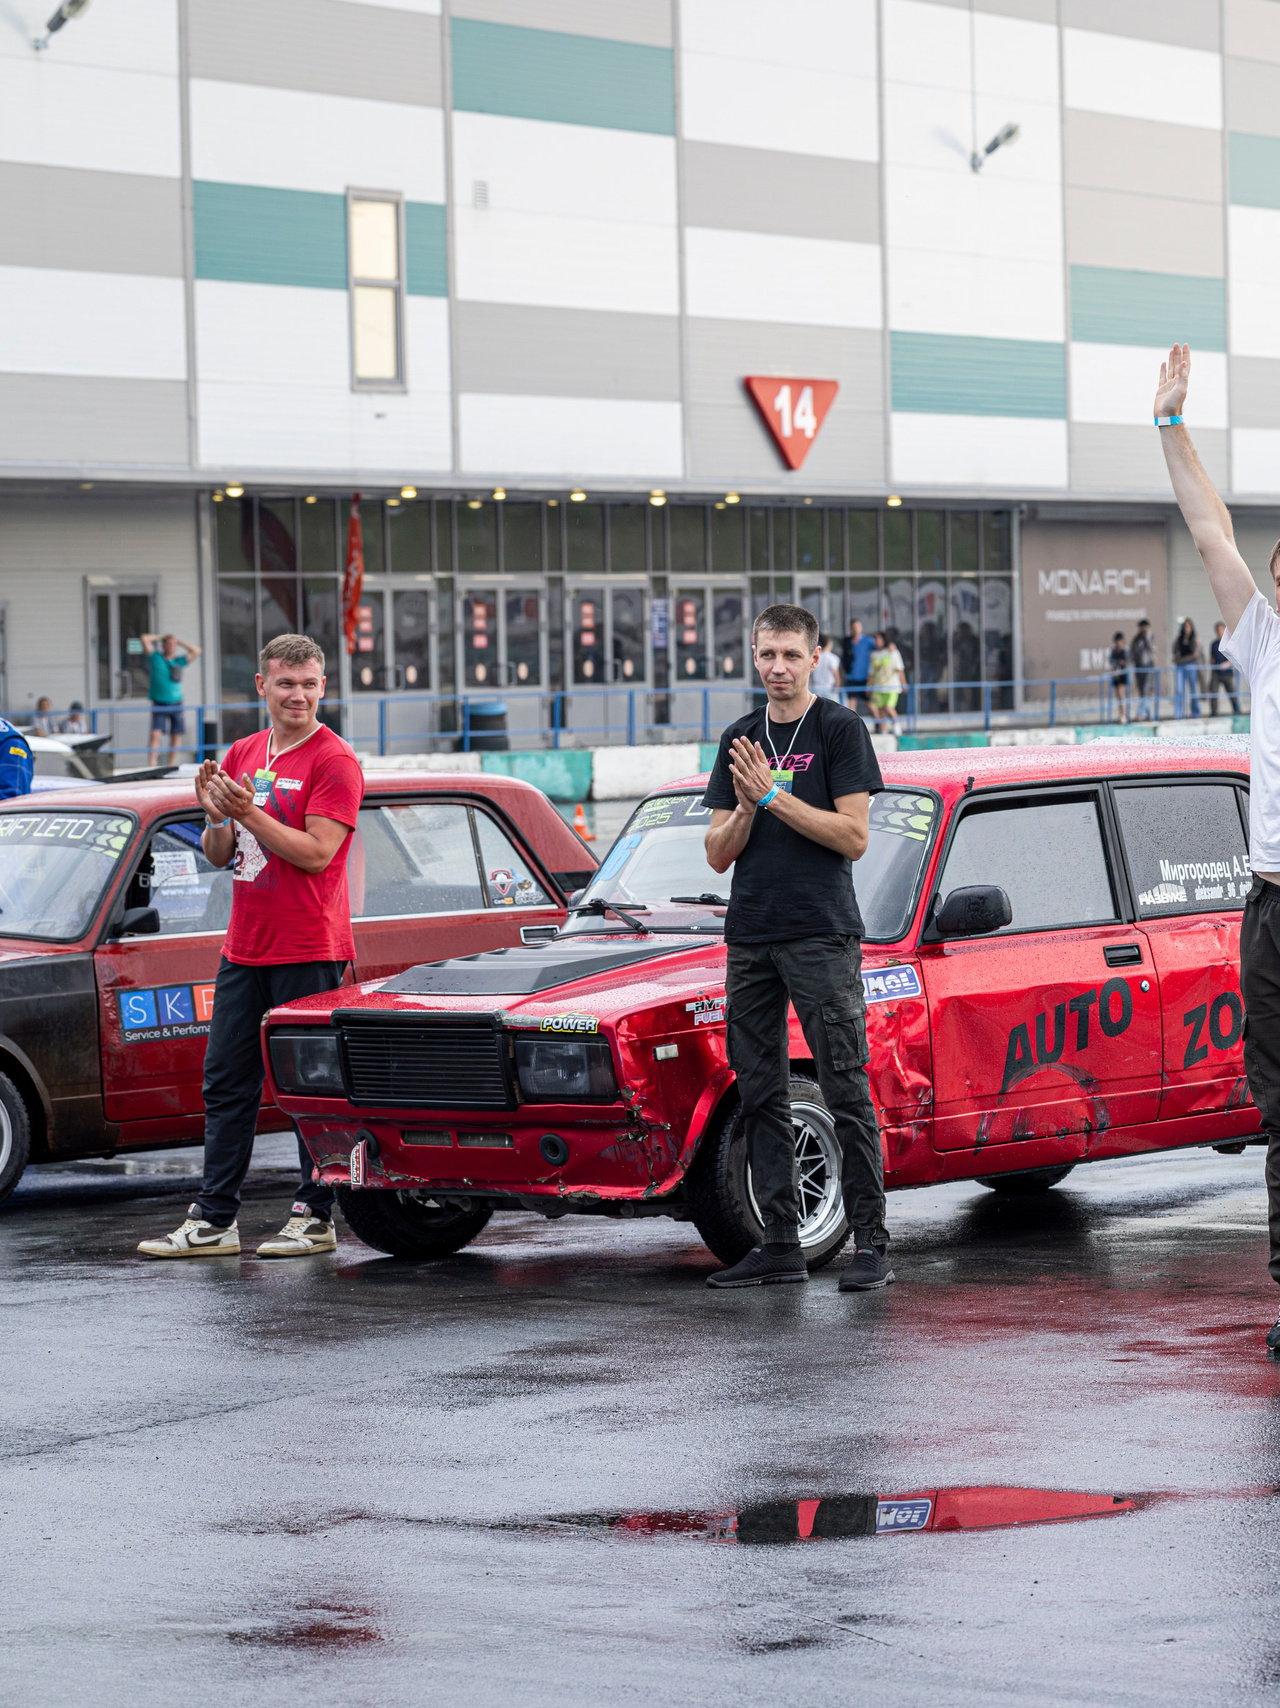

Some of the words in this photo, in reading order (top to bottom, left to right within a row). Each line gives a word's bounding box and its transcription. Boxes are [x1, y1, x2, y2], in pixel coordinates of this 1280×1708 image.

[774, 384, 817, 438] 14
[1038, 569, 1150, 596] MONARCH
[0, 818, 41, 838] RIFT
[33, 818, 94, 839] LETO
[1159, 859, 1232, 885] Миргородец
[862, 973, 918, 997] IMOL
[542, 1016, 598, 1031] POWER
[693, 1008, 725, 1026] FUEL
[125, 1030, 160, 1042] Service
[172, 1024, 211, 1036] Perfoma
[1001, 976, 1133, 1095] AUTO
[1182, 991, 1244, 1070] ZO
